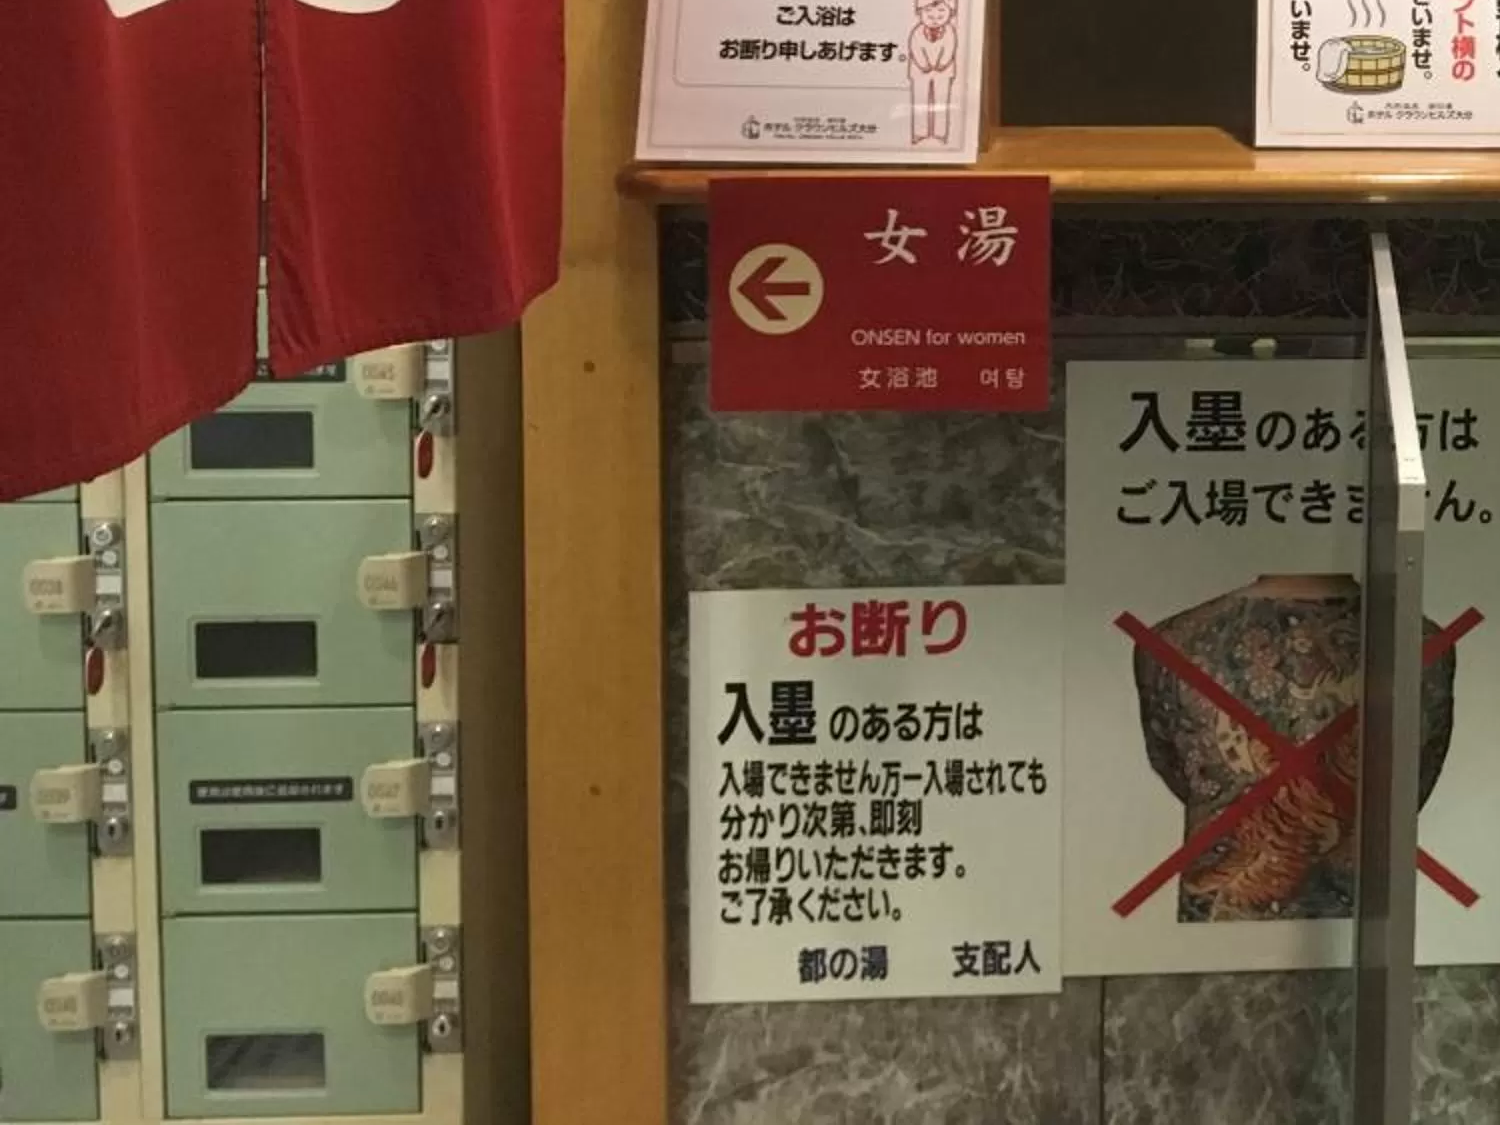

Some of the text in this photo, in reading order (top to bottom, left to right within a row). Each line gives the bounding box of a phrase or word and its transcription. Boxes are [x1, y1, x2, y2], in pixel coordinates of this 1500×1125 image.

[776, 6, 856, 27] ご入浴は
[719, 39, 907, 62] お断り申しあげます。
[863, 206, 1019, 268] 女湯
[851, 329, 1026, 346] ONSEN for women
[1116, 478, 1493, 526] ご入場できん。
[788, 599, 968, 658] お断り
[717, 680, 983, 746] 入墨のある方は
[718, 757, 1048, 798] 入場できません万一入場されても
[720, 800, 923, 840] 分かり次第、即刻
[718, 842, 966, 885] お帰りいただきます。
[720, 887, 902, 926] ご了承ください。
[798, 939, 1041, 984] 都の湯 支配人
